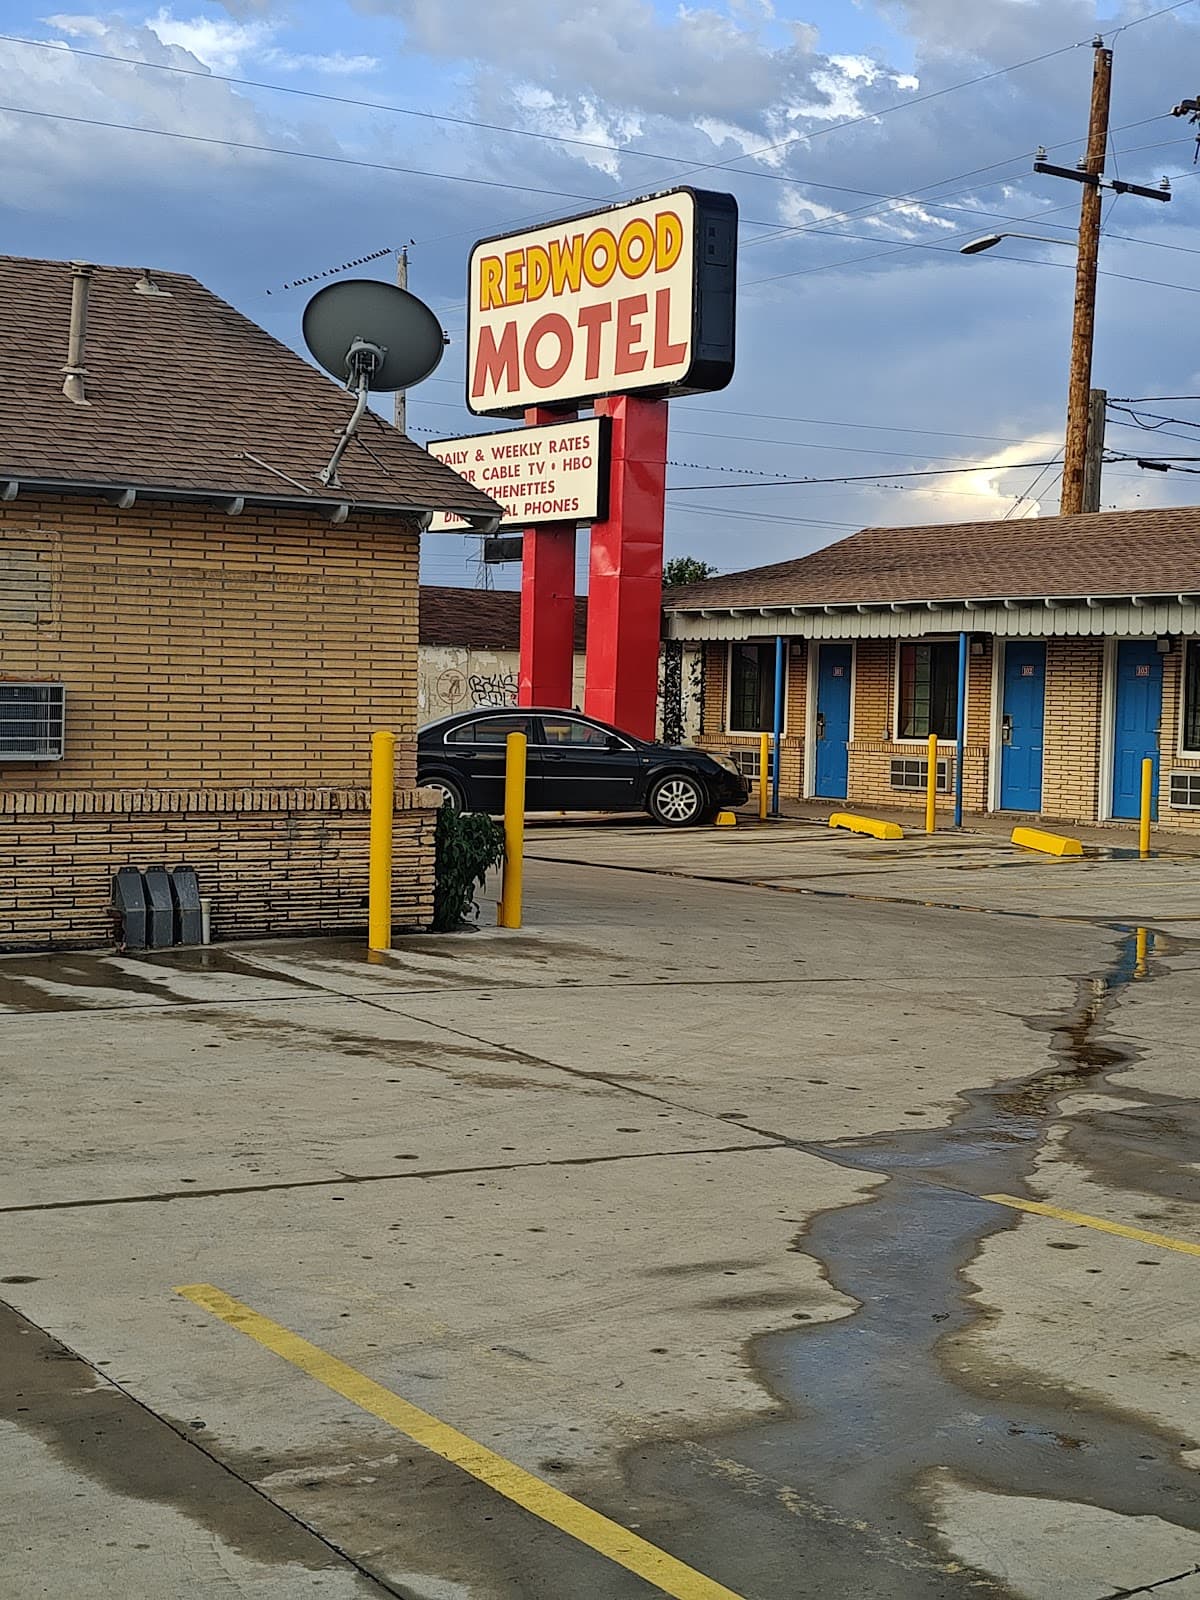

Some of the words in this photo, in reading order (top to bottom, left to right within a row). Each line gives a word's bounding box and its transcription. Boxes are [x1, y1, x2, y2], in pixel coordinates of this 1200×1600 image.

[480, 210, 683, 312] REDWOOD
[471, 287, 688, 397] MOTEL
[436, 450, 469, 466] DAILY
[475, 449, 485, 462] &
[491, 441, 542, 460] WEEKLY
[549, 435, 590, 454] RATES
[482, 464, 521, 481] CABLE
[528, 461, 545, 475] TV
[563, 456, 593, 472] HBO
[480, 480, 555, 499] CHENETTES
[524, 498, 579, 516] PHONES
